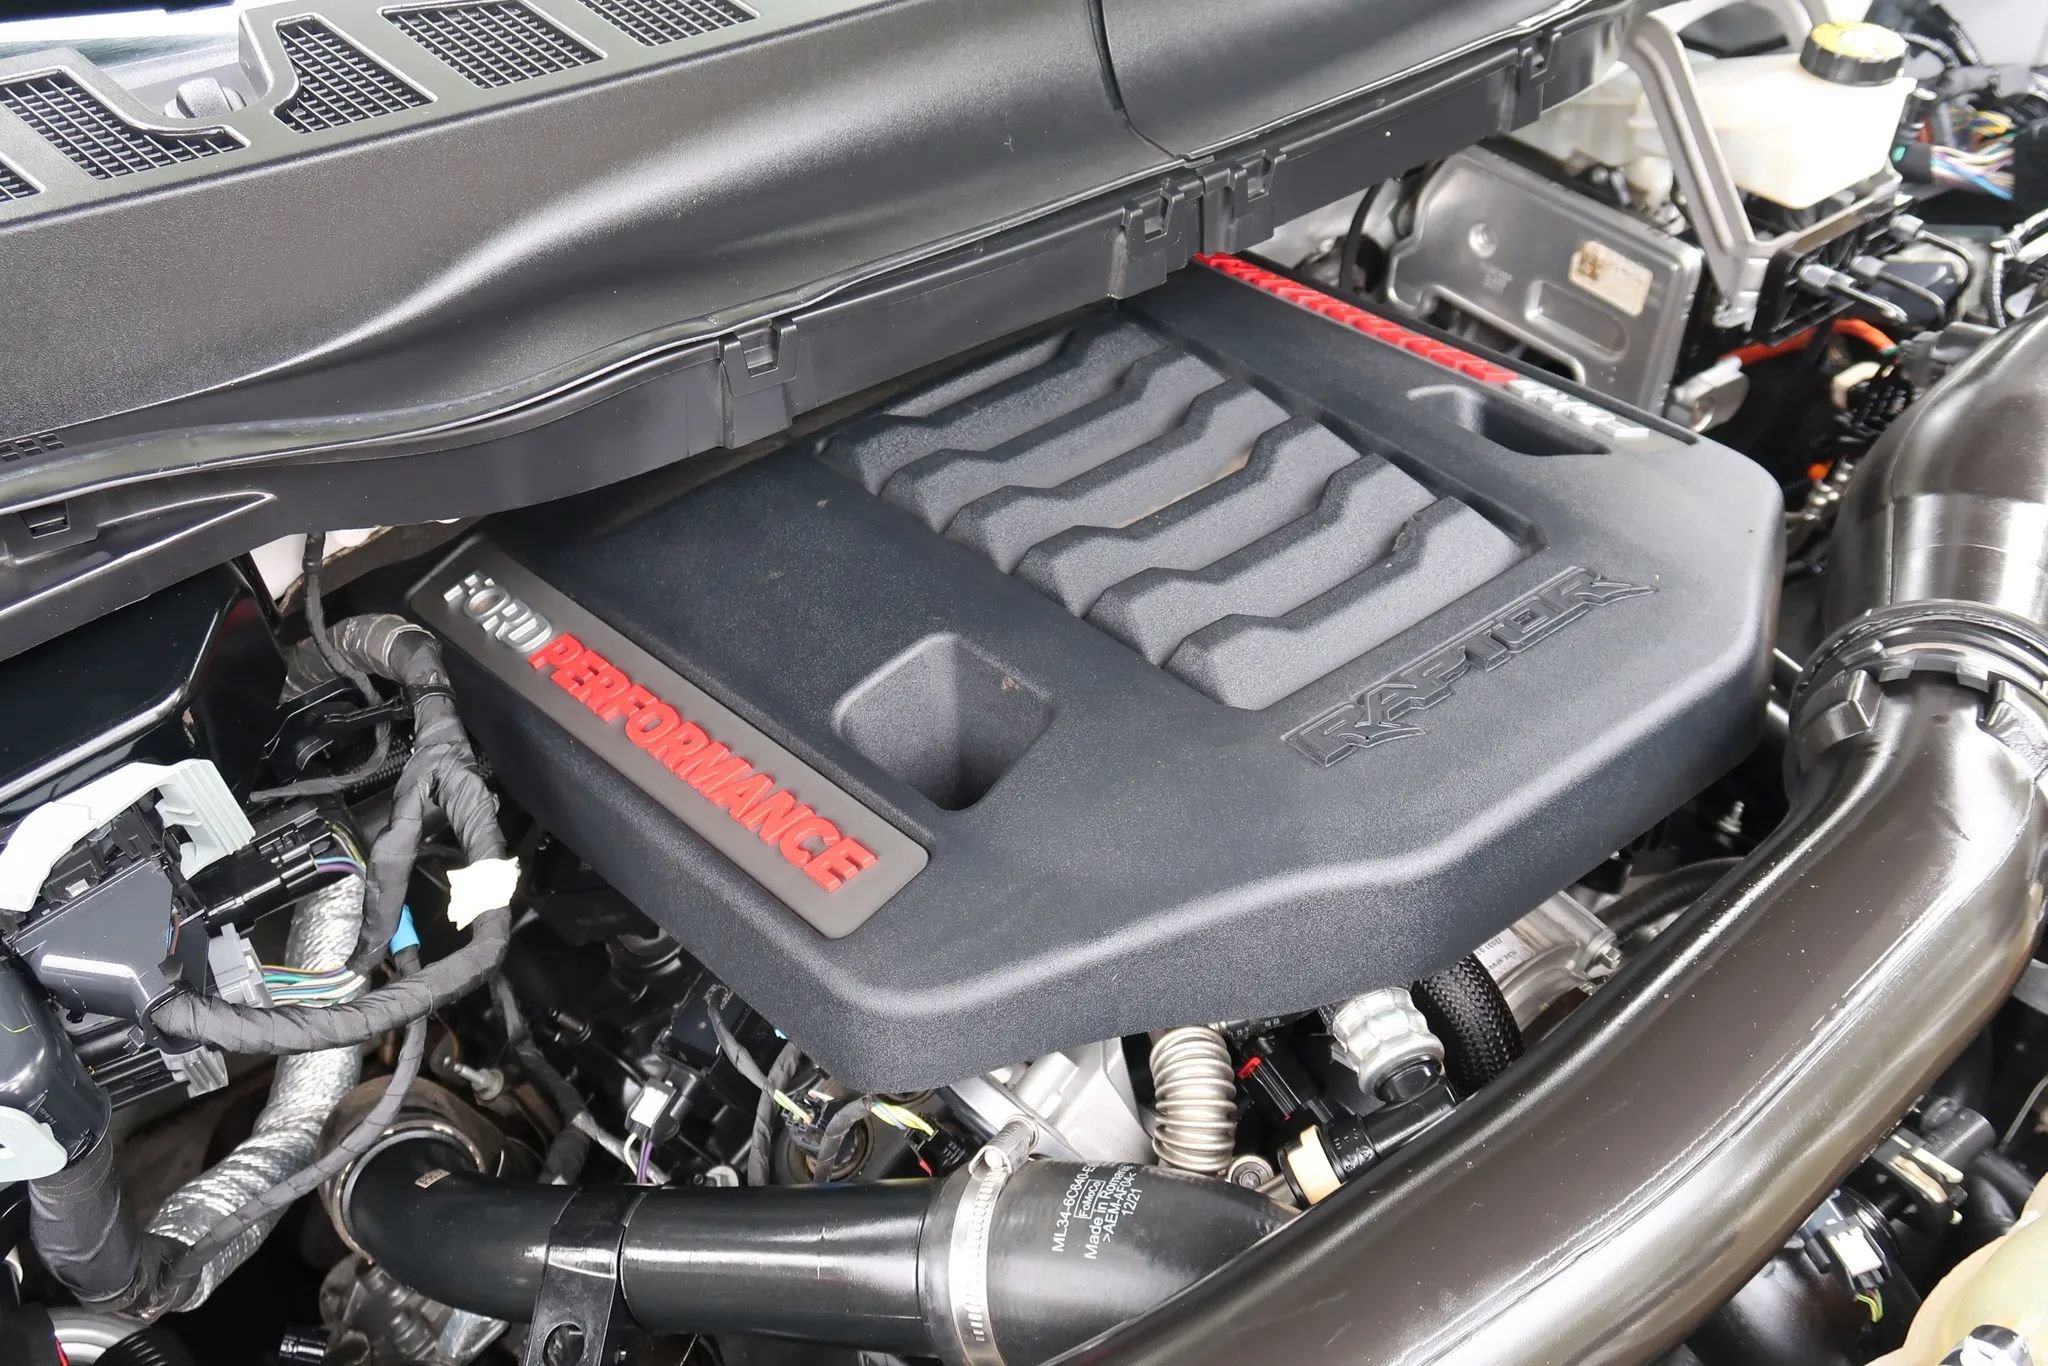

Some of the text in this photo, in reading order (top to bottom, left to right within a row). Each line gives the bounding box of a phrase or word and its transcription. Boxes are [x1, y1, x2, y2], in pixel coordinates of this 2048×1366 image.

[1281, 566, 1658, 767] RAPTOR
[443, 570, 878, 893] FORD PERFORMANCE
[1078, 1181, 1102, 1218] FoMoCo
[1121, 1188, 1143, 1216] 12/21
[1084, 1217, 1104, 1259] Made
[1094, 1203, 1108, 1214] in
